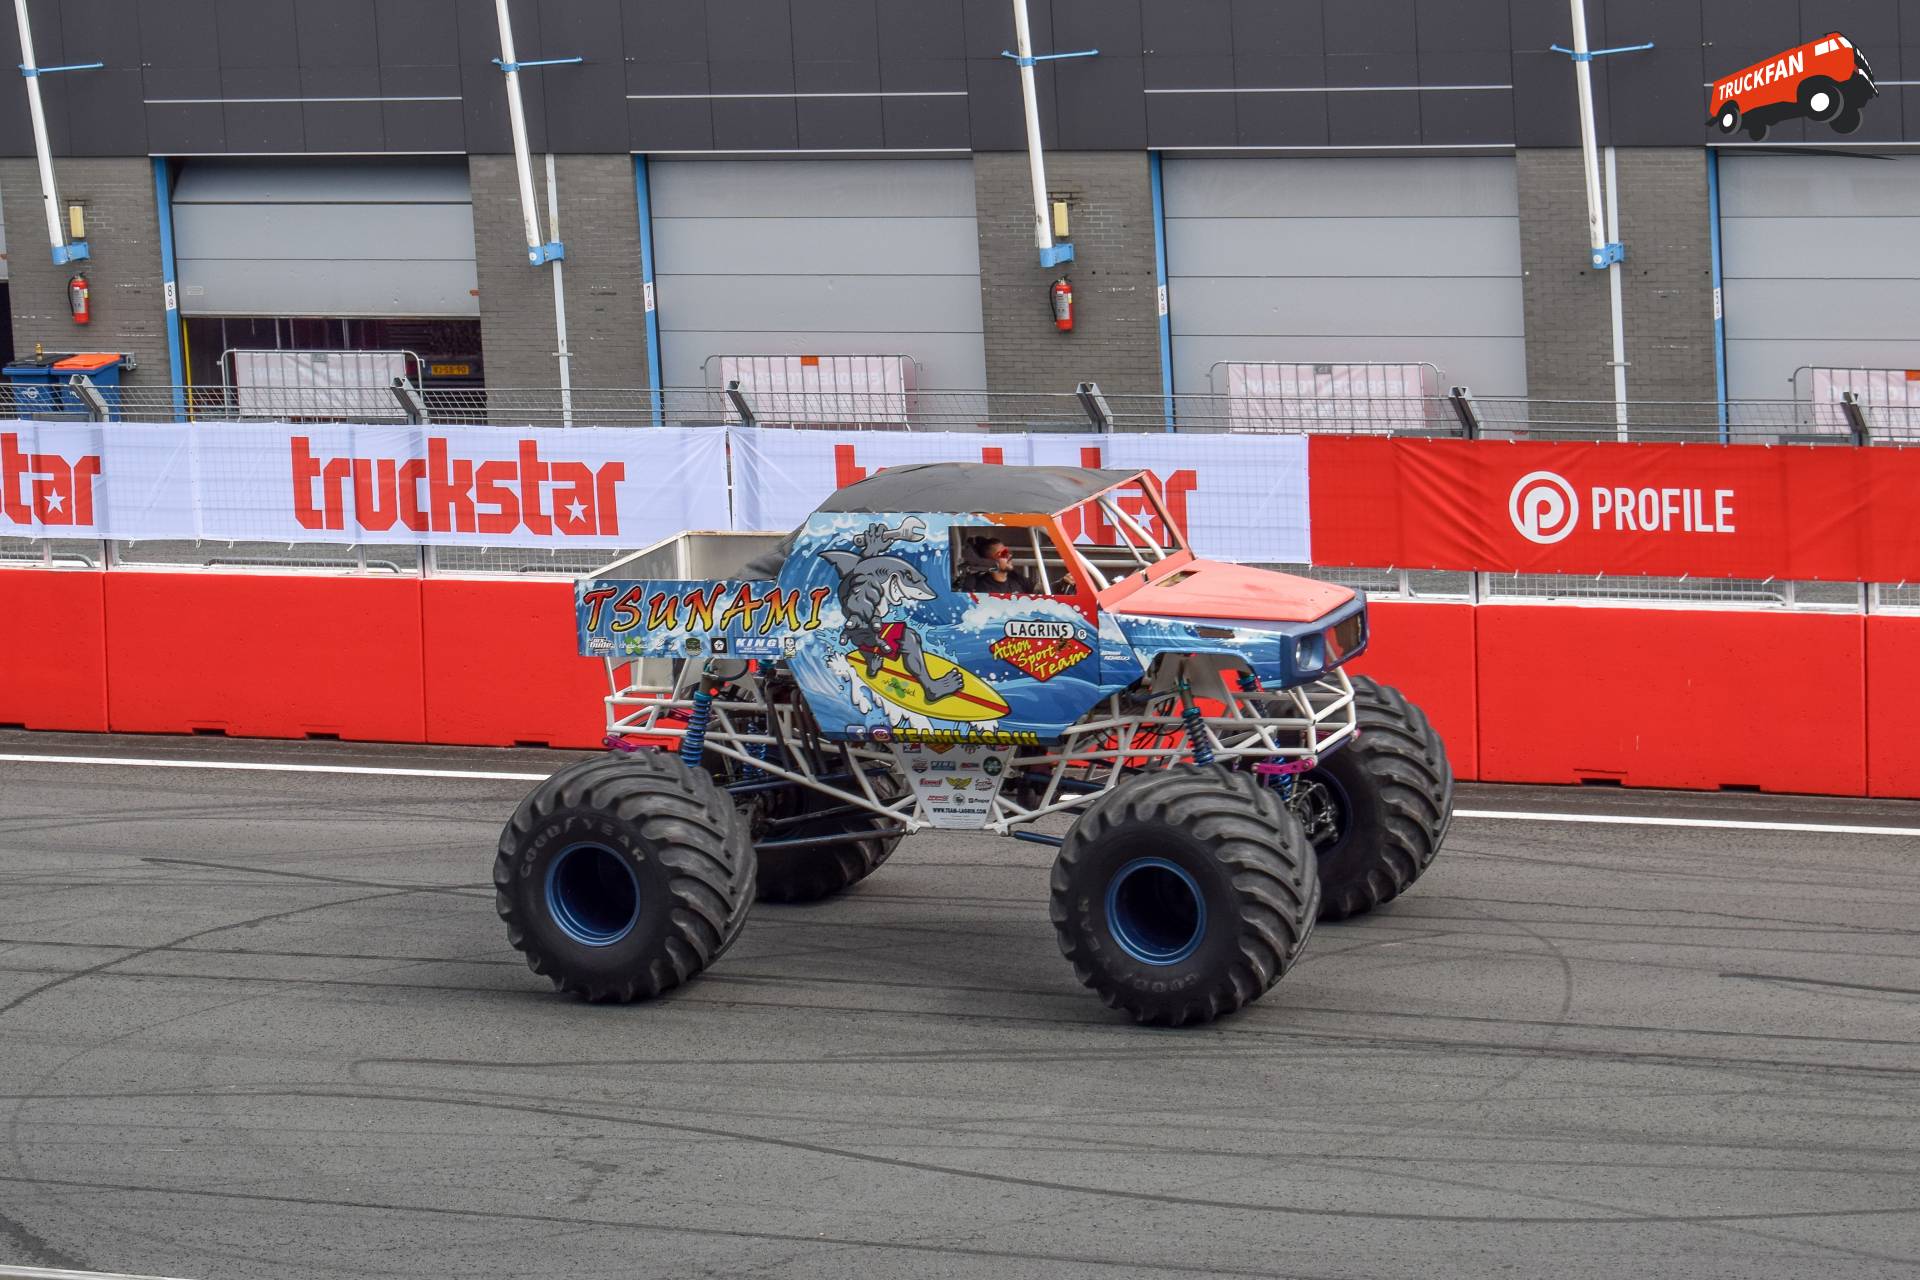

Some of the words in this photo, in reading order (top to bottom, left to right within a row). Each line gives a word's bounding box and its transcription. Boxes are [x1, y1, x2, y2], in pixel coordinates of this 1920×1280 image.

[0, 432, 101, 526] tar
[291, 436, 625, 536] truckstar
[1591, 486, 1736, 533] PROFILE
[583, 583, 831, 635] TSUNAMI
[736, 638, 778, 648] KING
[1010, 623, 1069, 637] LAGRINS
[993, 639, 1032, 661] Action
[1017, 644, 1056, 673] Sport
[1035, 651, 1089, 679] Team
[520, 815, 647, 879] GOODYEAR
